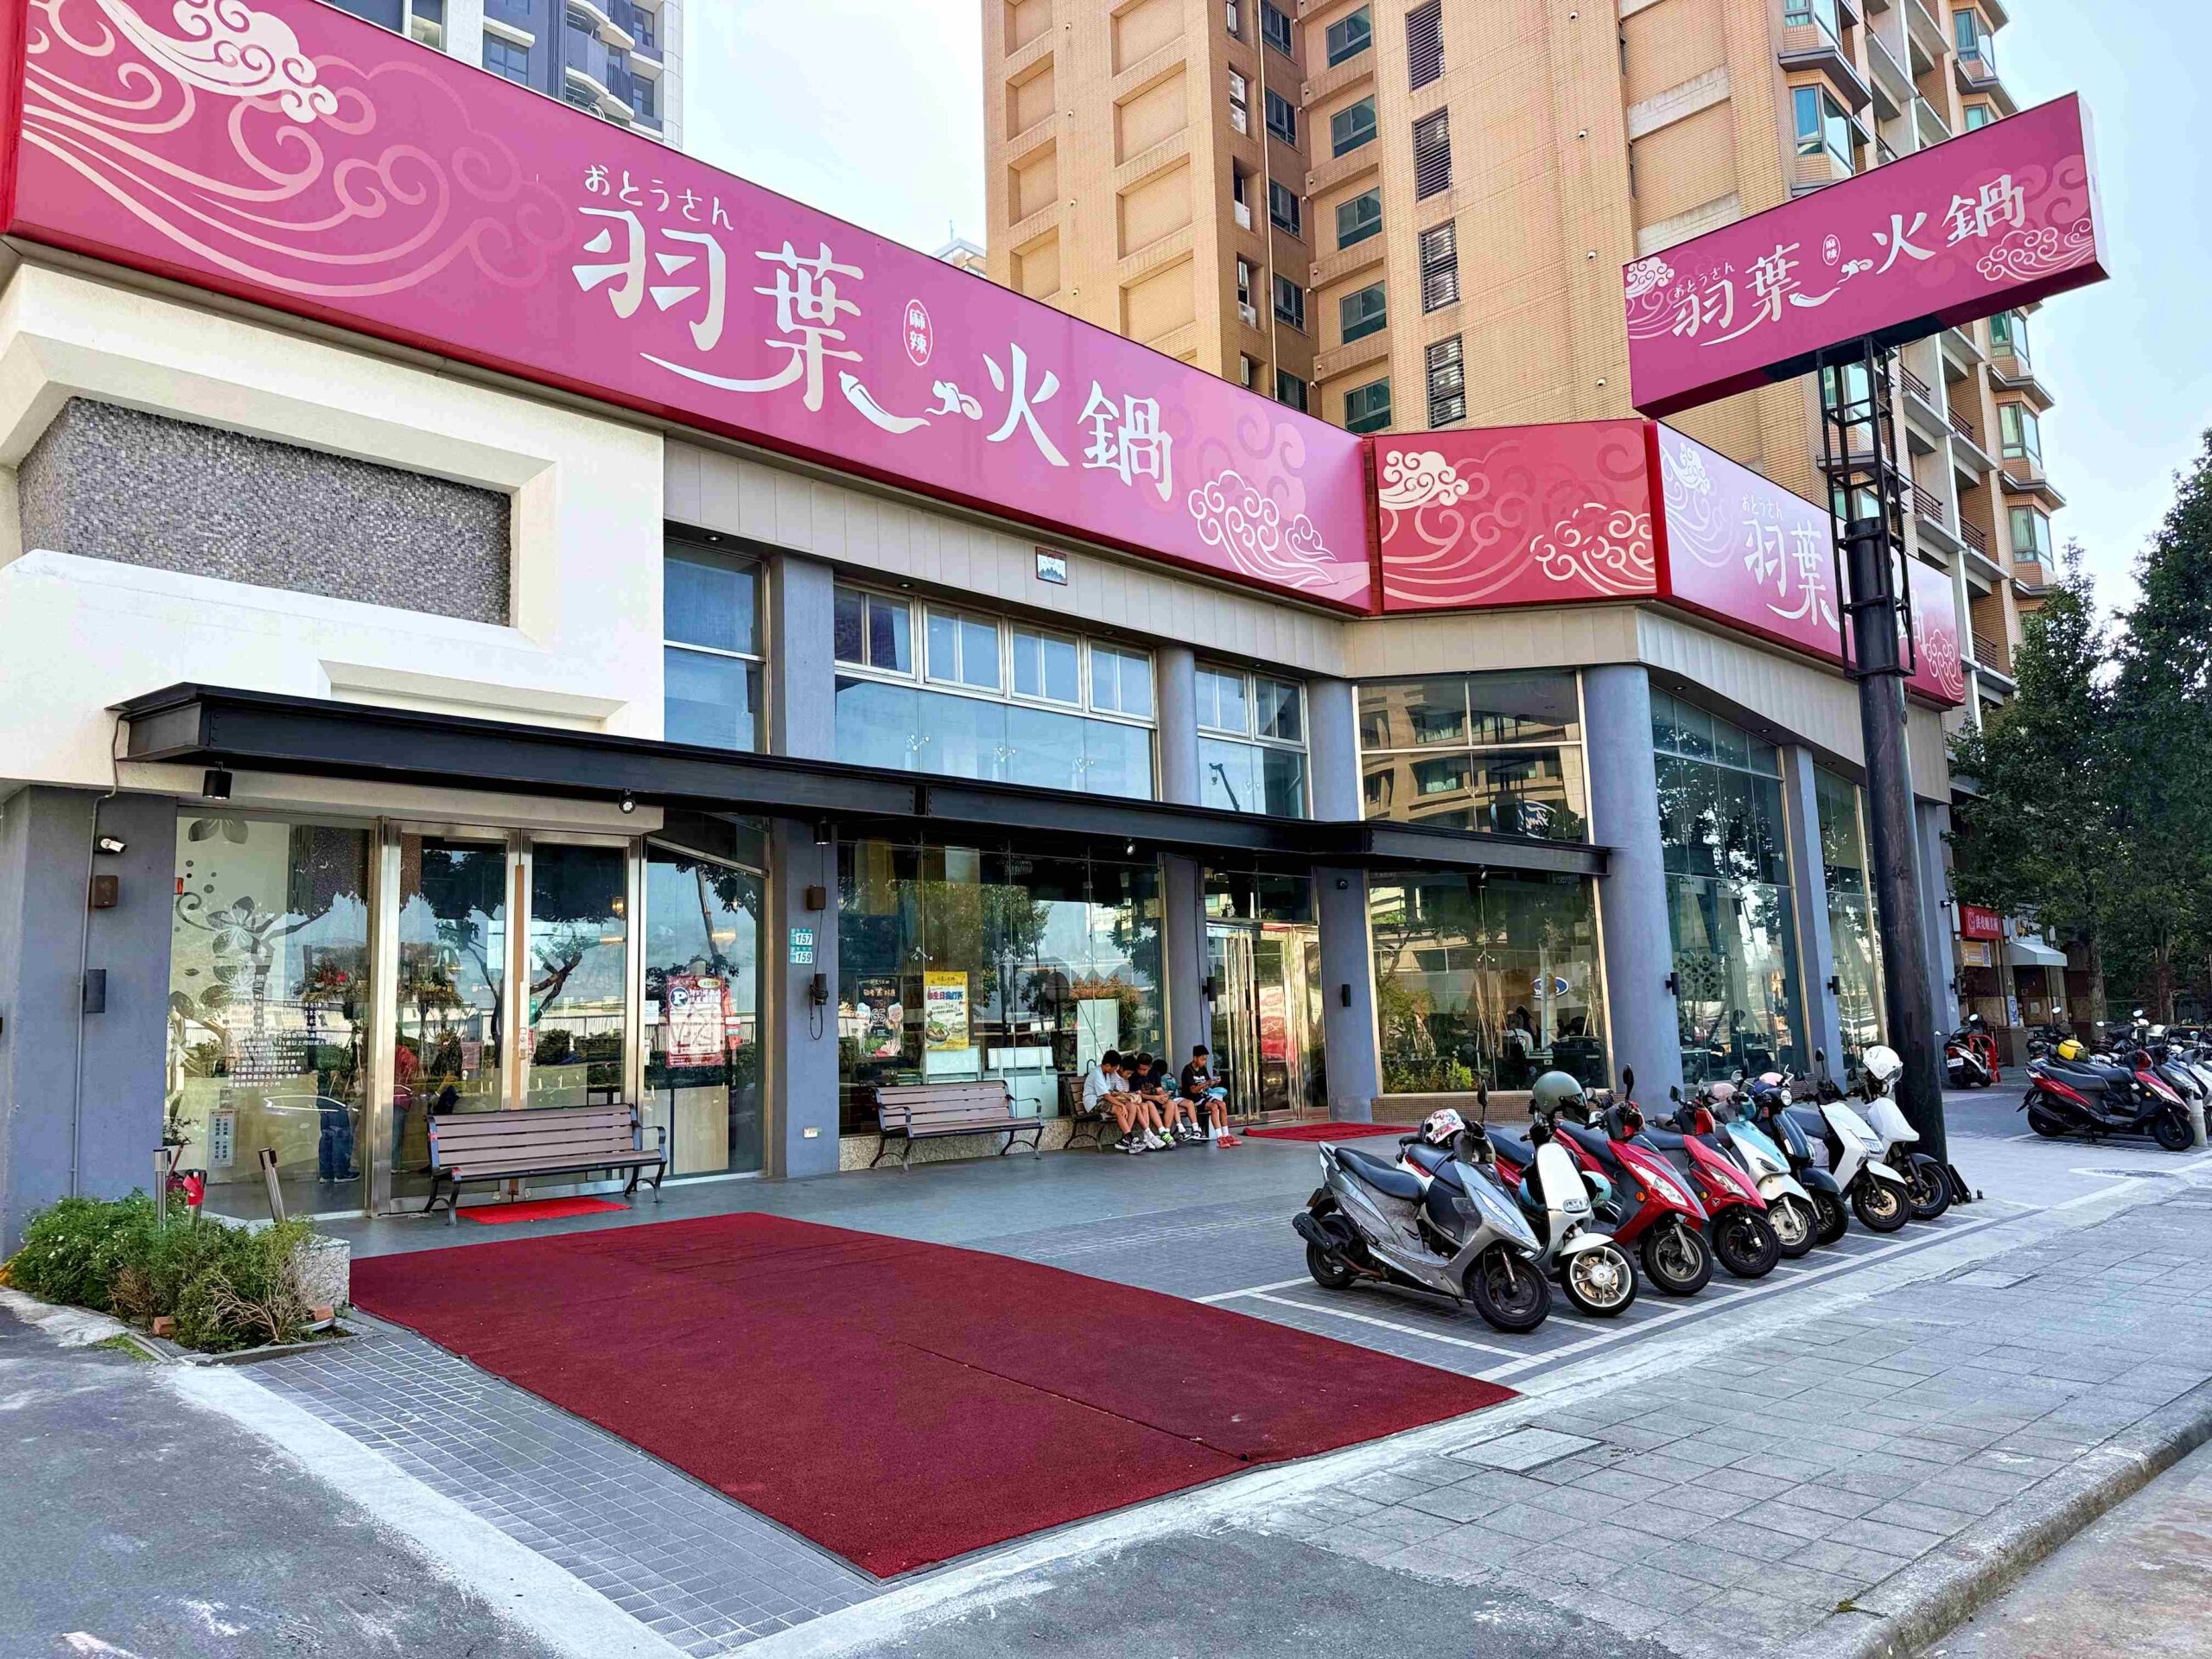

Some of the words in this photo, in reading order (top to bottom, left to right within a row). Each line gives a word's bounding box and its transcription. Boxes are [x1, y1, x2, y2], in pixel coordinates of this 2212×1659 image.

[584, 164, 734, 231] おとうさん
[1672, 242, 1801, 346] 羽葉
[1872, 175, 2024, 275] 火鍋
[1673, 261, 1735, 299] おとうさん
[908, 308, 929, 354] 麻辣
[571, 207, 865, 411] 羽葉
[982, 342, 1173, 501] 火鍋
[1741, 493, 1783, 520] おとうさん
[1742, 518, 1827, 626] 羽葉
[797, 934, 811, 944] 157
[797, 952, 812, 963] 159
[673, 990, 689, 1007] P
